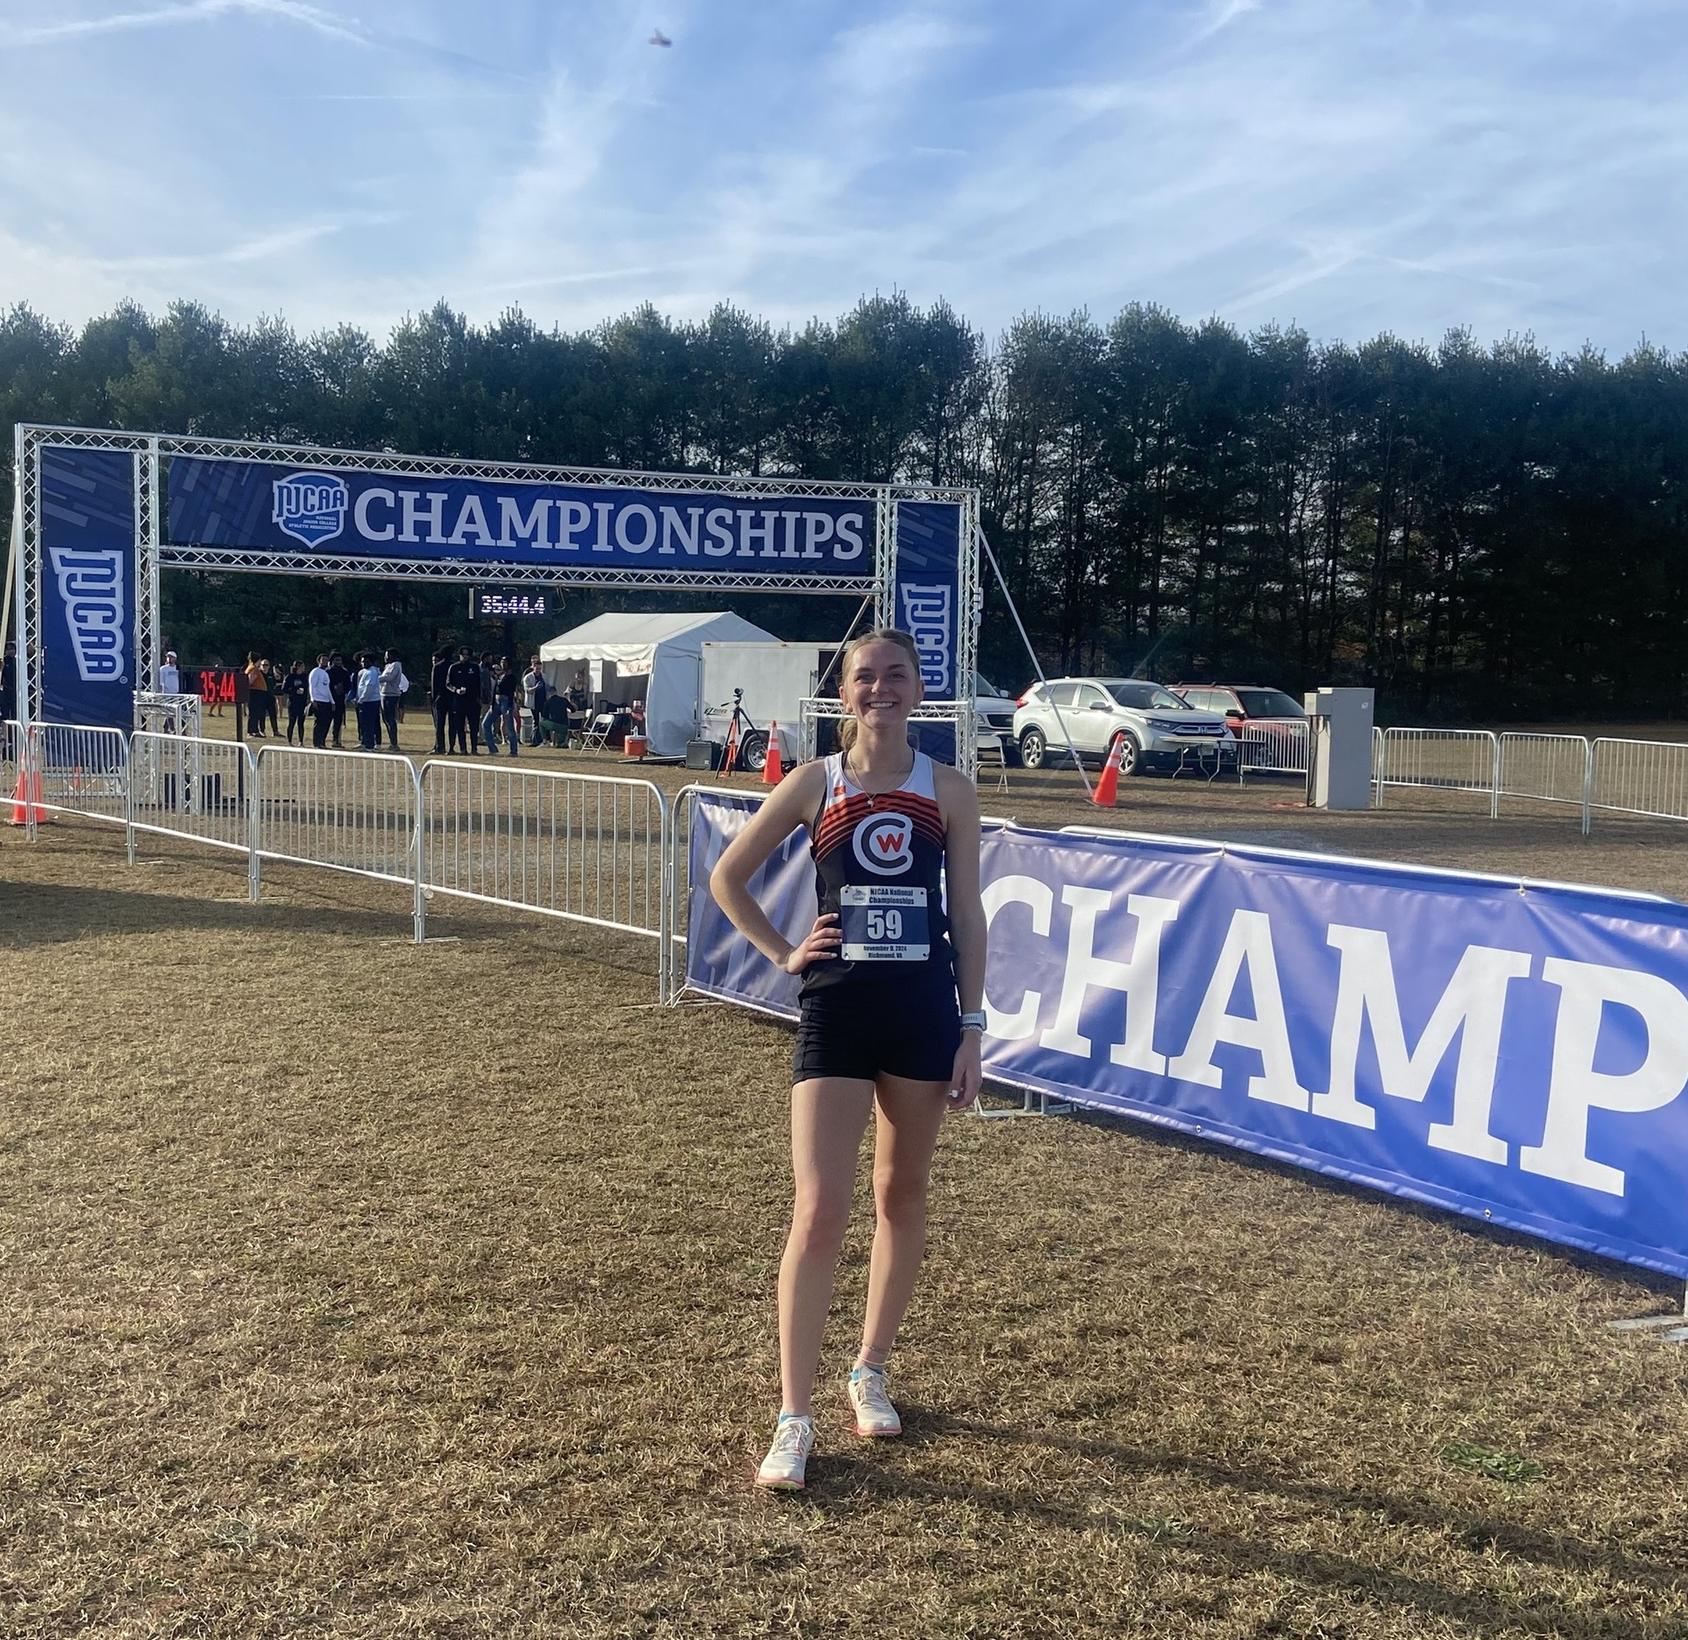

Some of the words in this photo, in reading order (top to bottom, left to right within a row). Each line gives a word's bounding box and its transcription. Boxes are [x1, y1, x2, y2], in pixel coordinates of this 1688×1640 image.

[274, 482, 346, 519] NJCAA
[355, 488, 863, 560] CHAMPIONSHIPS
[53, 550, 121, 678] NJCAA
[481, 596, 545, 614] 35:44.4
[903, 586, 947, 689] NJCAA
[199, 671, 236, 703] 35:44
[869, 896, 914, 904] Championships
[890, 889, 913, 897] National
[867, 909, 903, 940] 59
[980, 874, 1688, 1196] CHAMP
